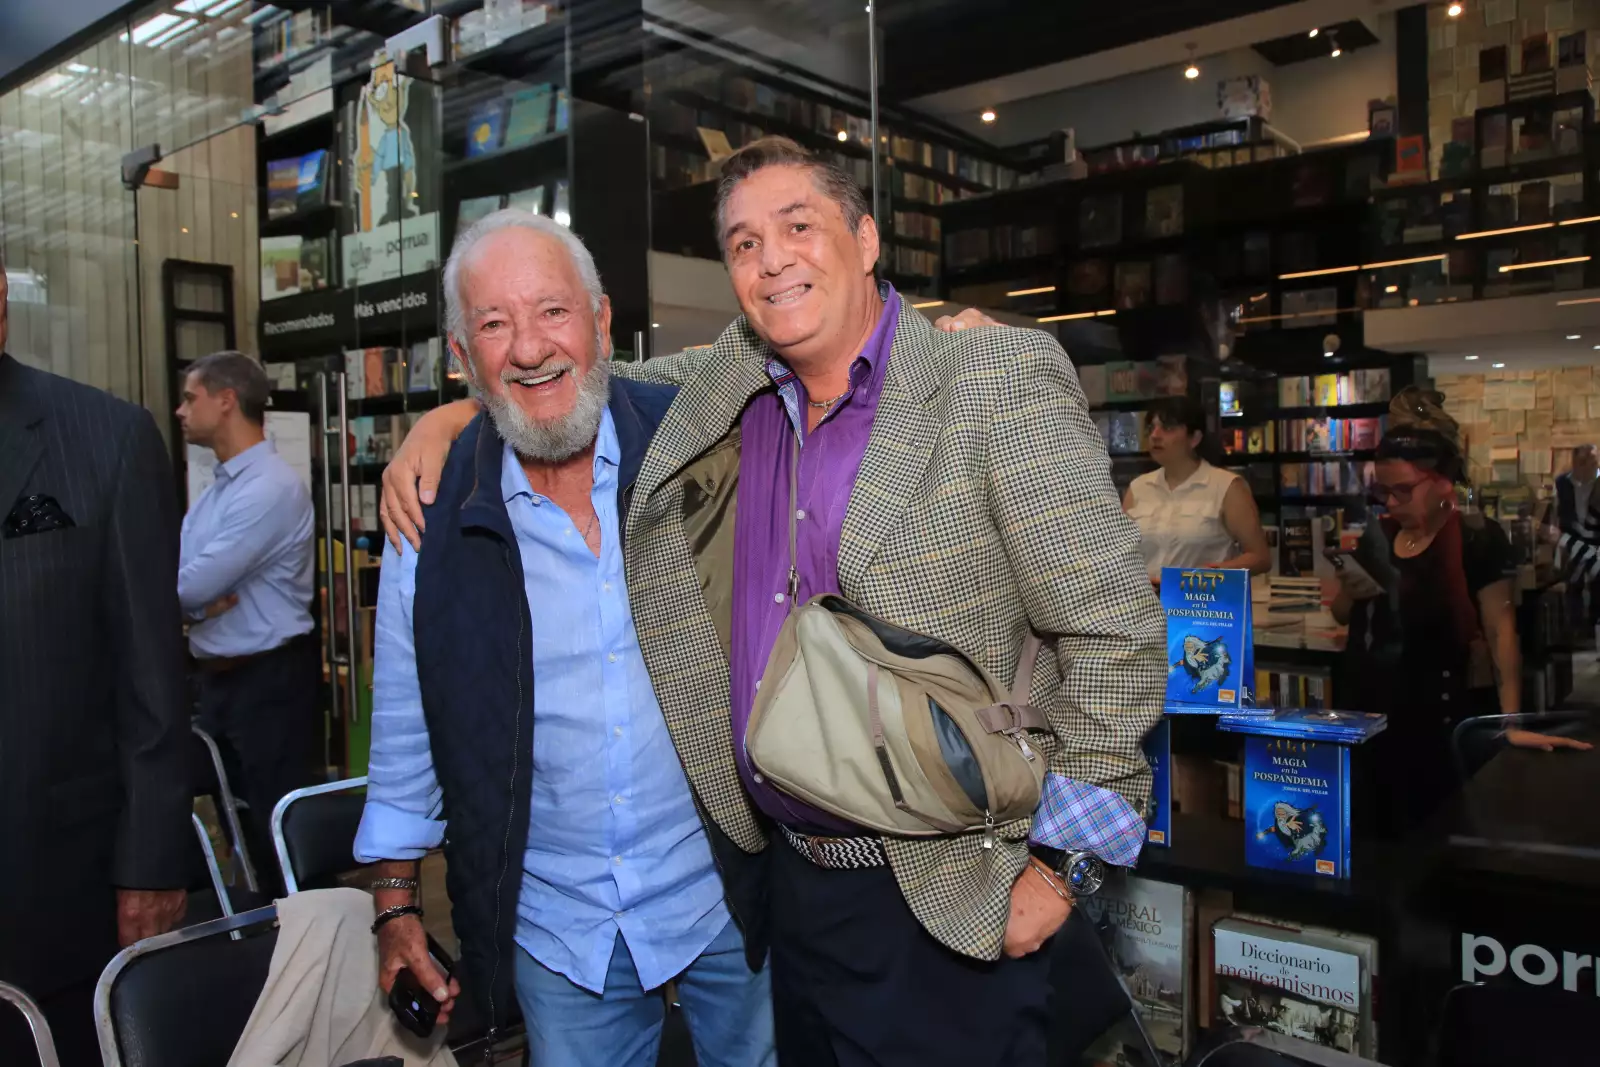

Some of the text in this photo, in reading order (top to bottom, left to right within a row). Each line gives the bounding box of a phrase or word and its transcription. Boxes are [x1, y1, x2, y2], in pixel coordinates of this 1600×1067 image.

[263, 312, 335, 335] Recomendados
[1184, 592, 1216, 602] MAGIA
[1167, 608, 1234, 620] POSPANDEMIA
[1272, 756, 1307, 768] MAGIA
[1291, 767, 1298, 775] la
[1254, 772, 1328, 788] POSPANDEMIA
[1085, 896, 1161, 923] ATEDRAL
[1241, 941, 1331, 975] Diccionario
[1279, 966, 1290, 976] de
